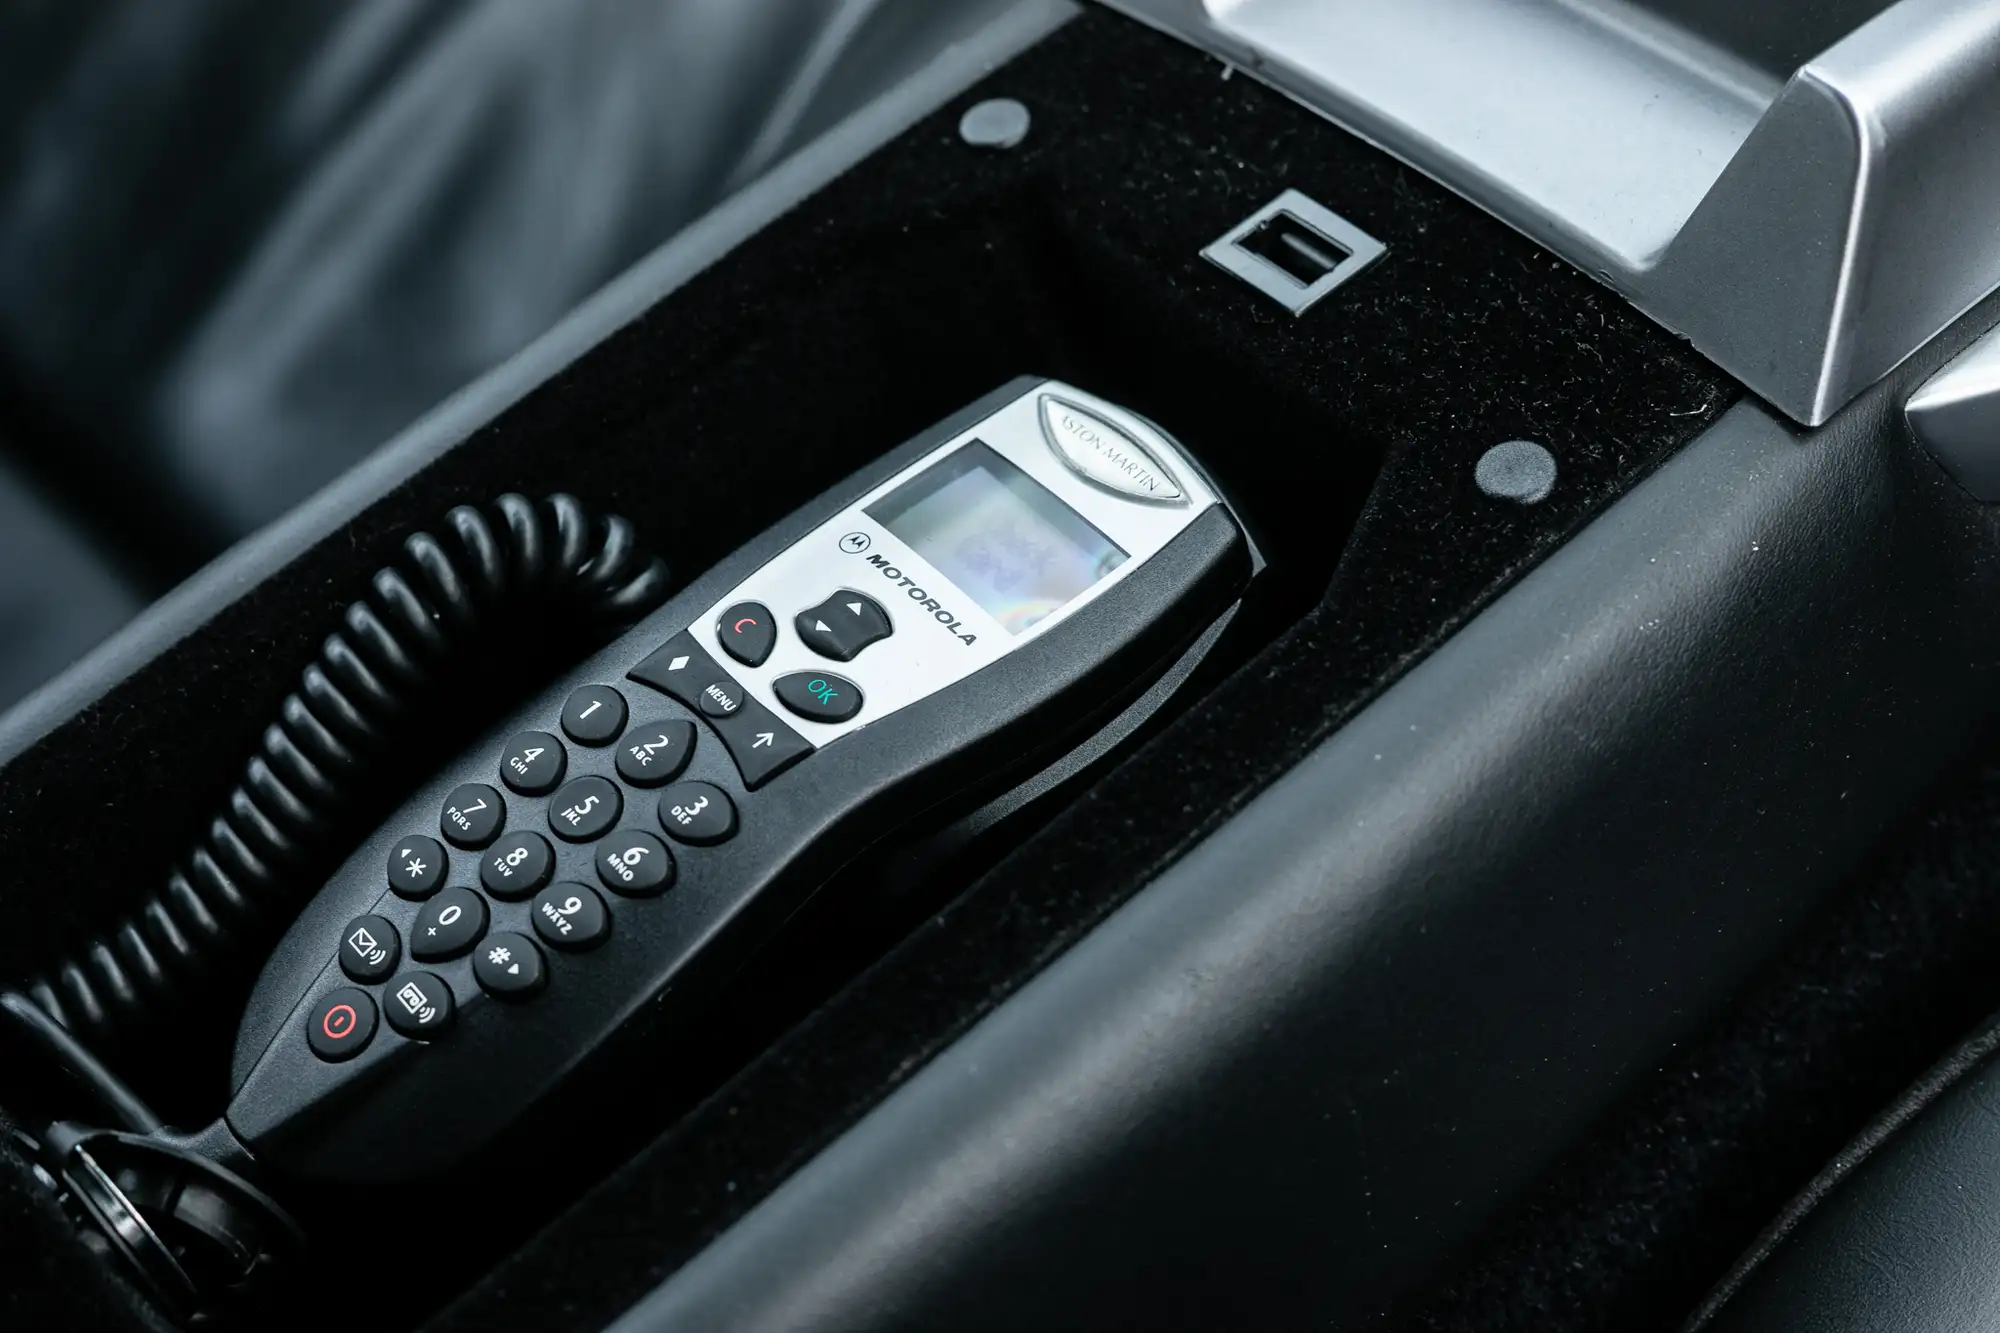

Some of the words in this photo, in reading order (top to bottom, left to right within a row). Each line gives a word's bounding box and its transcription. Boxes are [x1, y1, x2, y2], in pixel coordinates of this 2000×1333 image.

[1103, 447, 1161, 492] MARTIN
[865, 554, 977, 646] MOTOROLA
[734, 618, 757, 634] C
[705, 684, 737, 712] MENU
[807, 679, 838, 705] OK
[579, 700, 602, 720] 1
[523, 747, 545, 764] 4
[643, 734, 669, 756] 2
[510, 756, 529, 775] GHI
[629, 745, 653, 767] ABC
[462, 798, 488, 814] 7
[574, 795, 600, 815] 5
[670, 805, 693, 826] DEF
[684, 795, 709, 816] 3
[446, 806, 472, 831] PQRS
[560, 807, 582, 827] JKL
[505, 847, 529, 867] 8
[622, 846, 650, 866] 6
[493, 857, 513, 877] TUV
[606, 853, 634, 882] MNO
[438, 905, 462, 926] 0
[557, 896, 583, 916] 9
[541, 902, 574, 935] WXYZ
